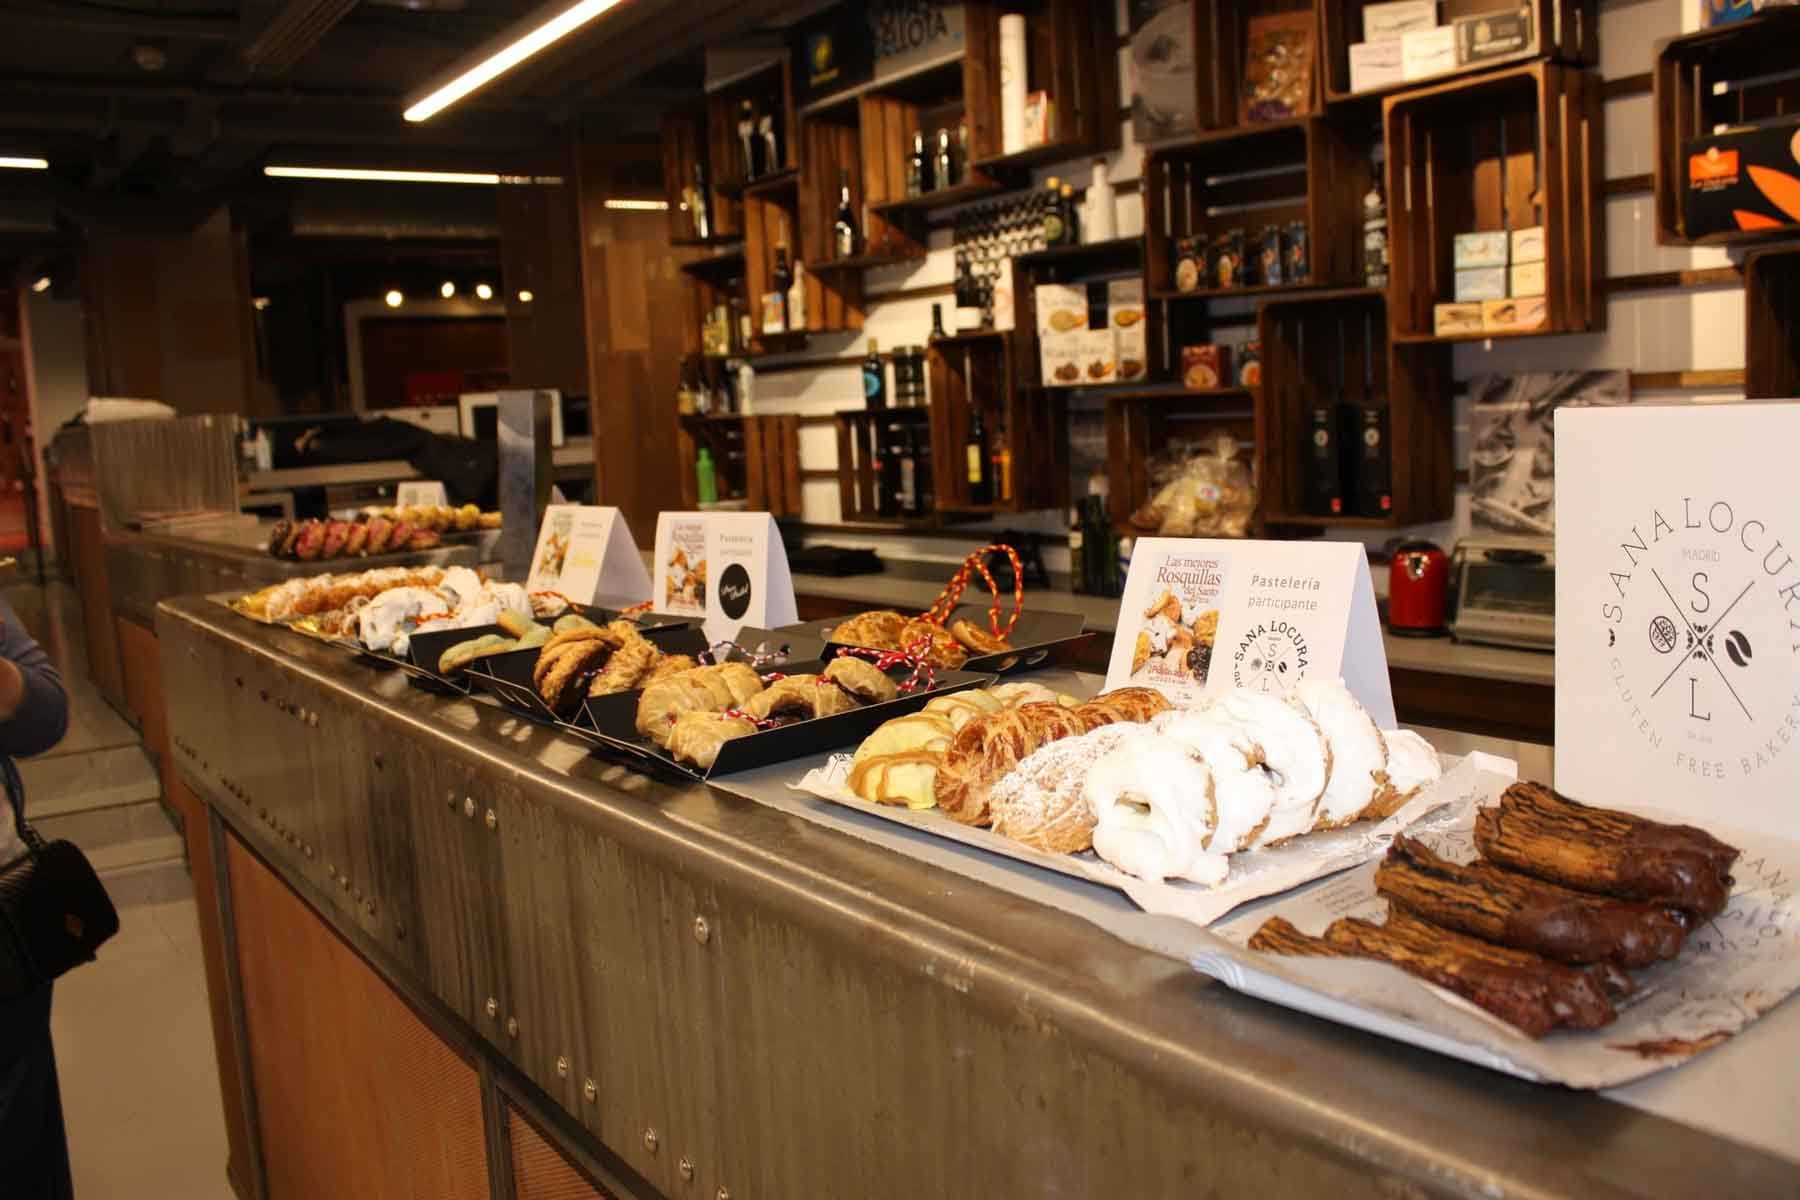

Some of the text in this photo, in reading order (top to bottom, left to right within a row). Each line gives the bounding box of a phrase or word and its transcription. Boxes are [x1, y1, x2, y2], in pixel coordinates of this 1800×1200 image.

[1166, 554, 1219, 570] Las mejores
[1682, 548, 1720, 562] MADRID
[1156, 566, 1222, 588] Rosquillas
[1251, 574, 1321, 591] Pastelería
[1247, 596, 1319, 611] participante
[1610, 656, 1662, 749] GLUTEN
[1675, 751, 1727, 779] FREE
